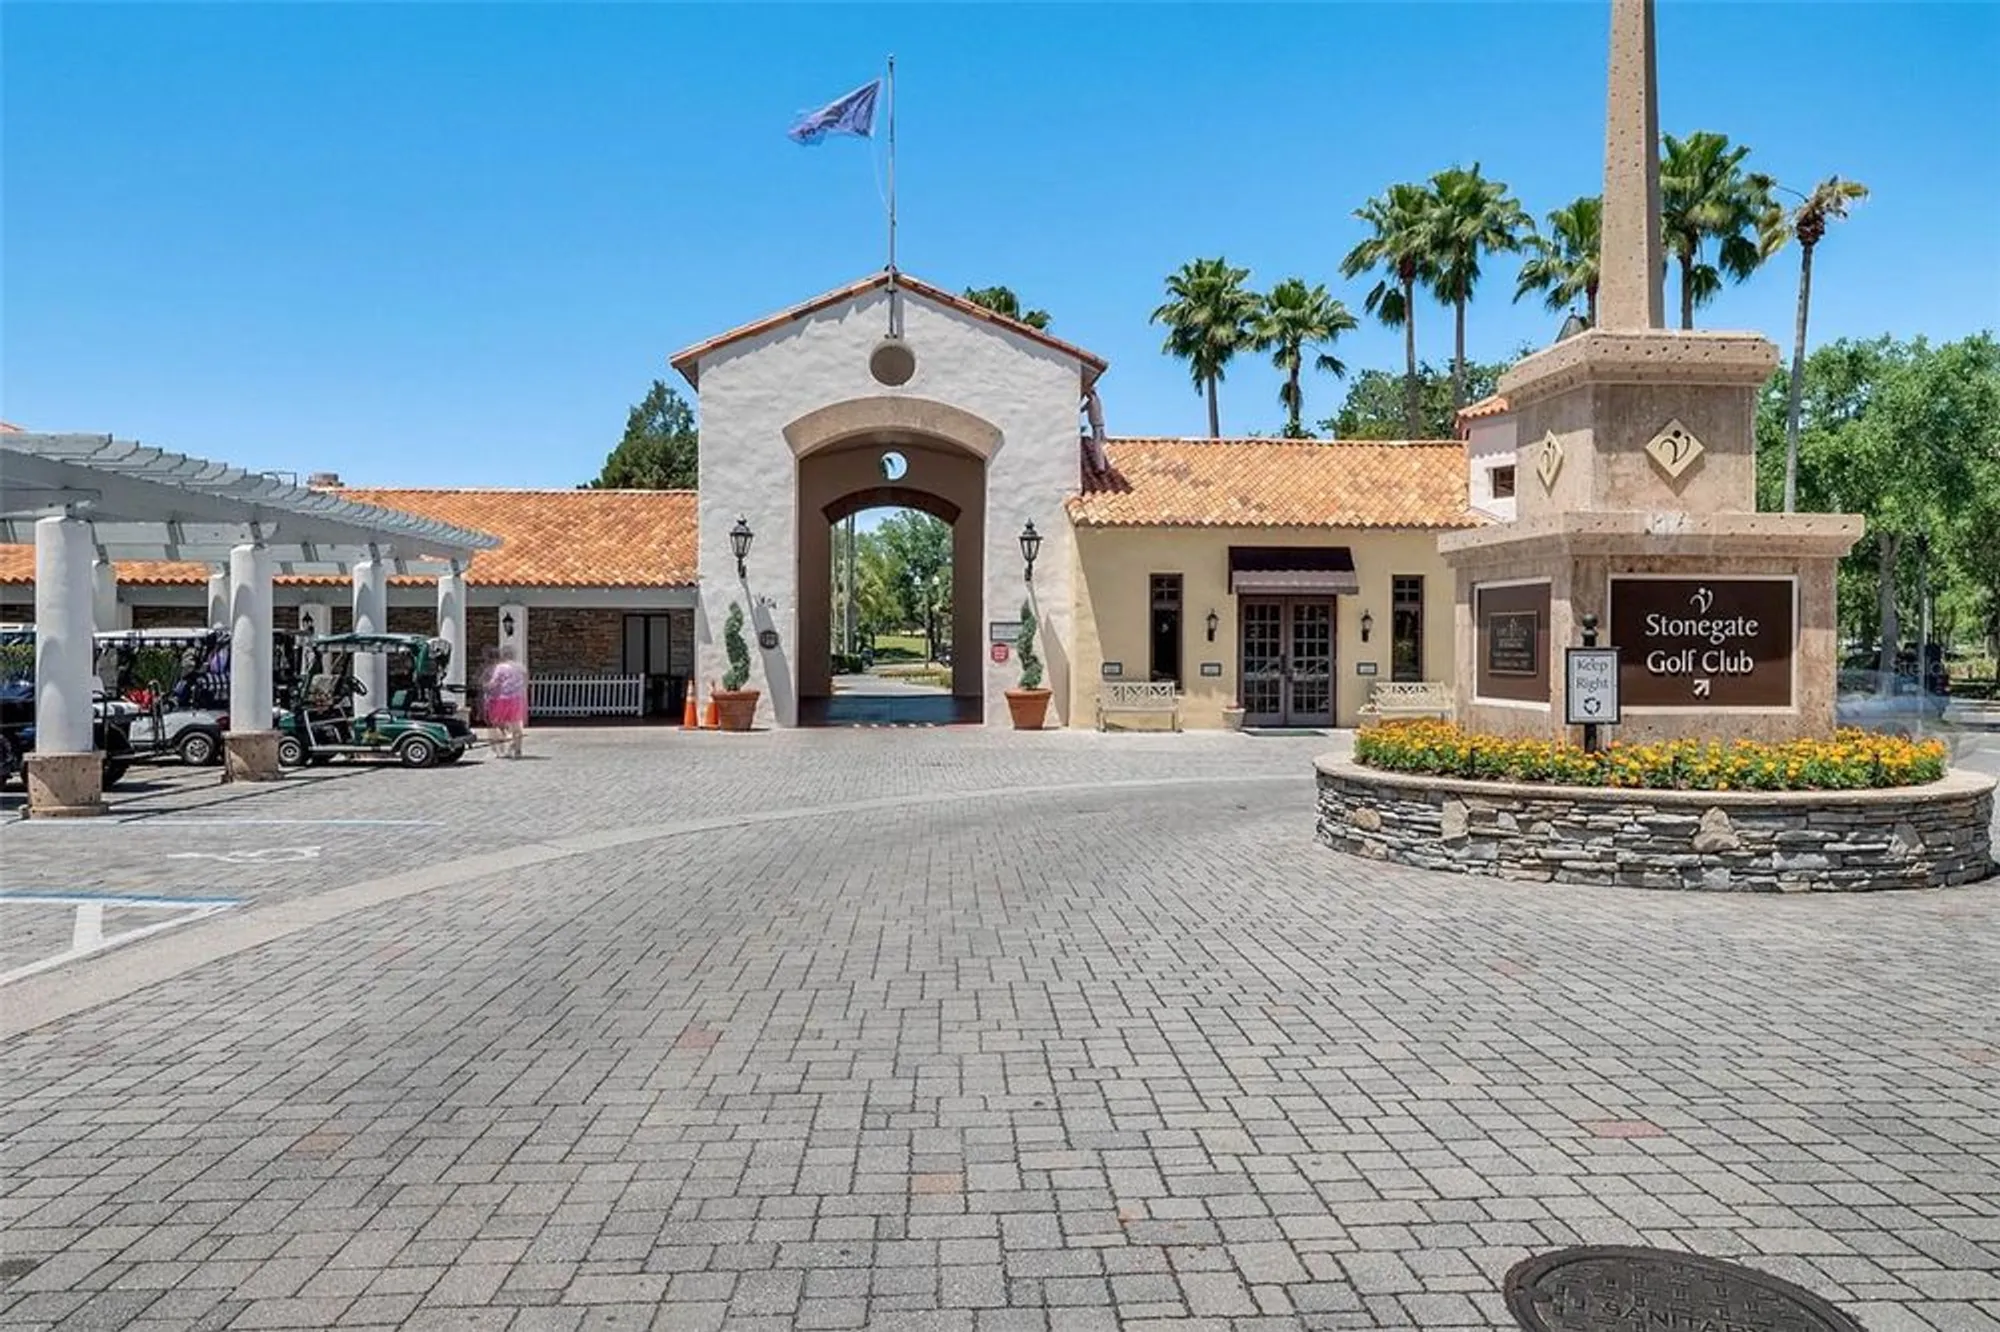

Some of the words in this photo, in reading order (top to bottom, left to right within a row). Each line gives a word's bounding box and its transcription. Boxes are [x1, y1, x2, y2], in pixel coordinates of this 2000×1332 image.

[1645, 613, 1759, 645] Stonegate
[1577, 658, 1609, 673] Keep
[1646, 649, 1697, 673] Golf
[1701, 649, 1754, 673] Club
[1576, 676, 1609, 693] Right
[1601, 1300, 1756, 1332] SANITA
